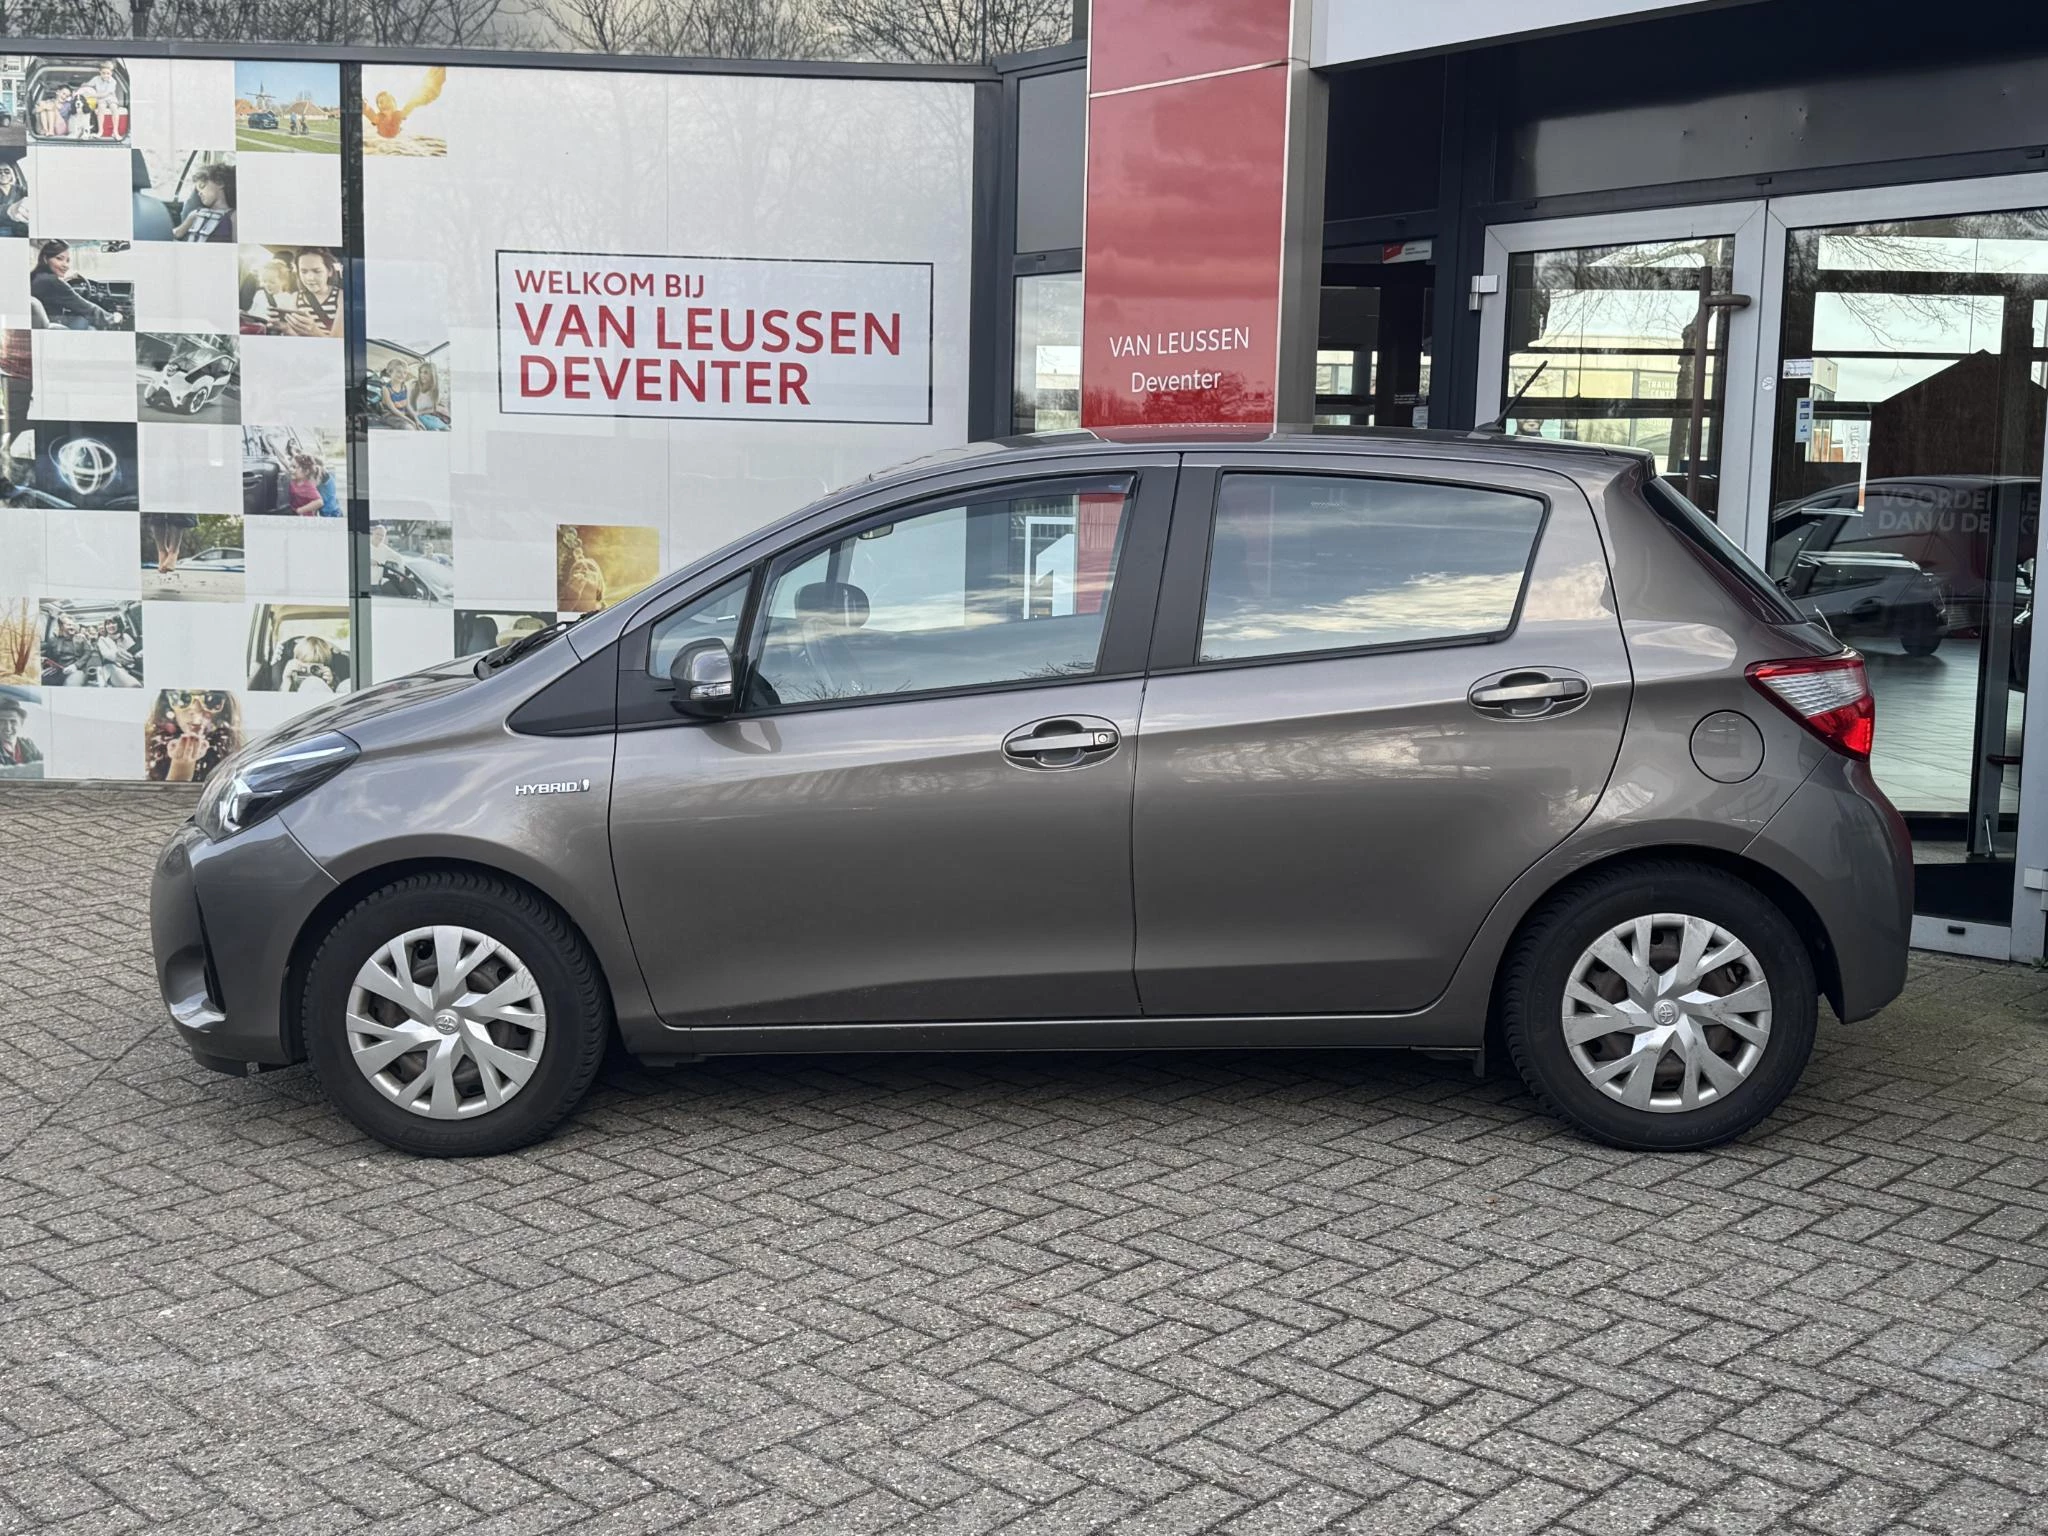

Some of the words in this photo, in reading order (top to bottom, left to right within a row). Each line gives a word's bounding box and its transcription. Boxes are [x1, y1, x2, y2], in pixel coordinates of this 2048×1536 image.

[514, 269, 655, 297] WELKOM
[665, 274, 705, 299] BIJ
[515, 303, 635, 349] VAN
[656, 306, 900, 356] LEUSSEN
[1109, 333, 1151, 358] VAN
[1157, 326, 1250, 356] LEUSSEN
[519, 354, 811, 406] DEVENTER
[1131, 369, 1222, 394] Deventer
[1878, 510, 1933, 531] DAN
[1939, 512, 1955, 532] U
[515, 781, 578, 796] HYBRID
